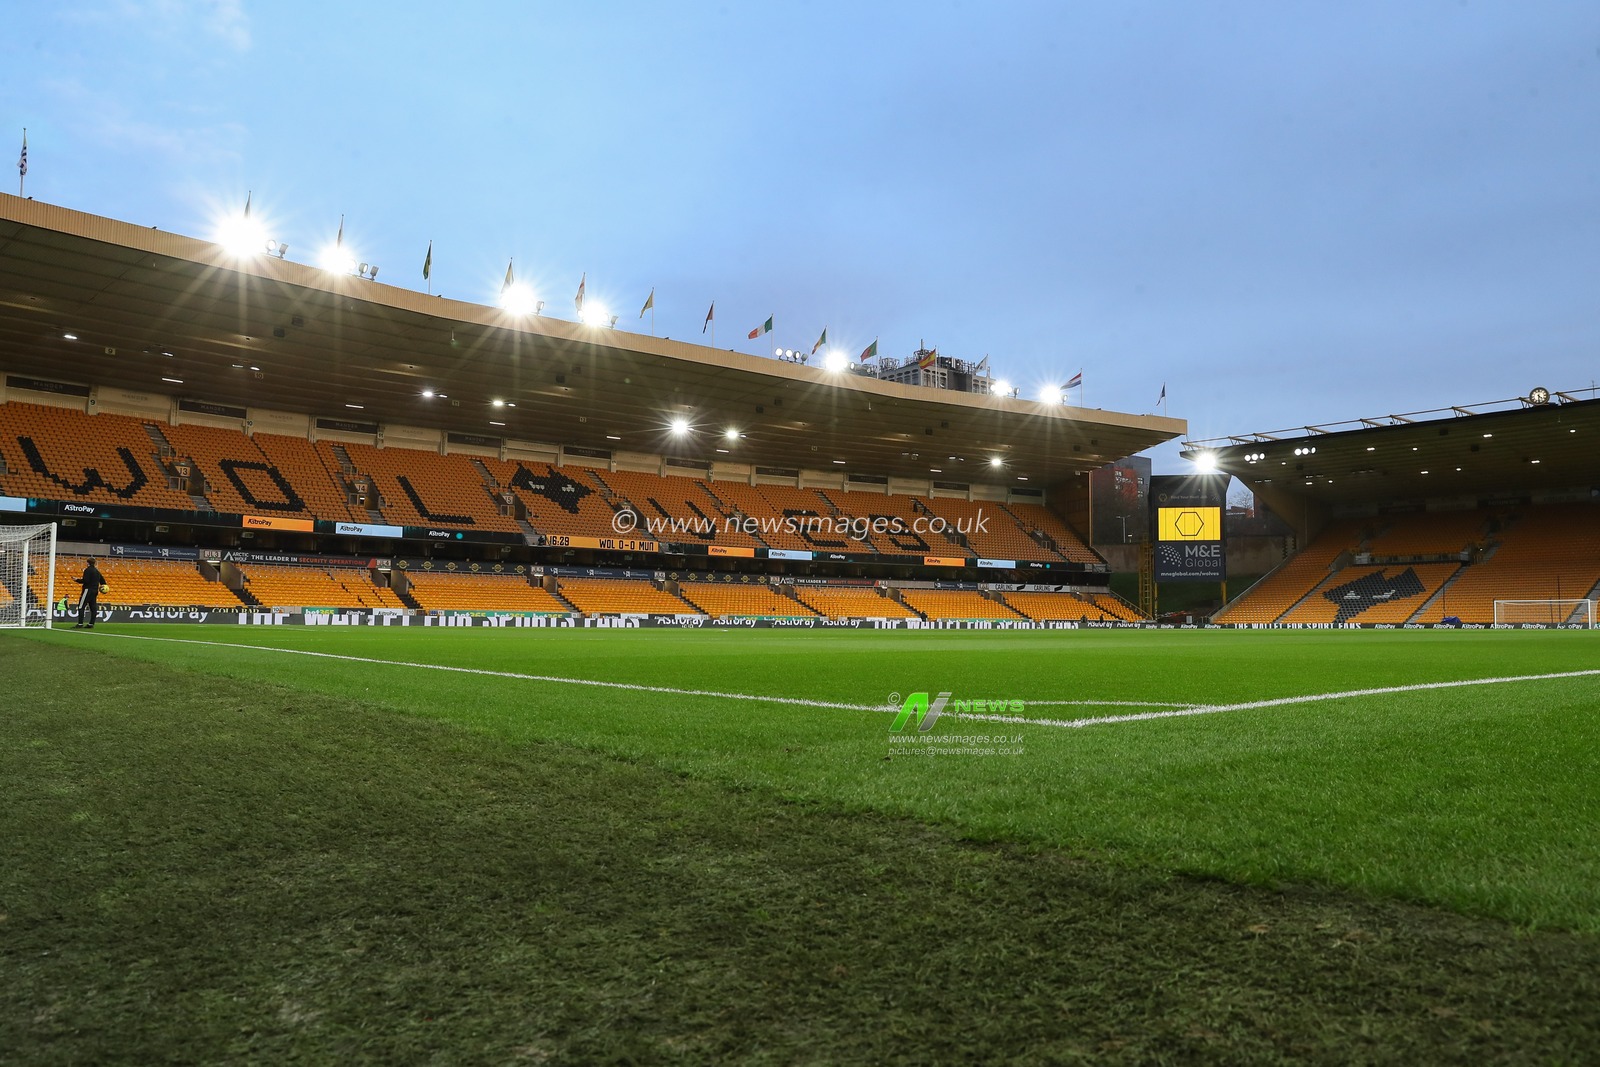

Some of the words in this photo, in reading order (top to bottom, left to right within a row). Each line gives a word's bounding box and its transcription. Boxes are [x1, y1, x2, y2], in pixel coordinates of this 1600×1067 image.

[64, 504, 95, 514] AstroPay
[247, 518, 272, 527] AstroPay
[339, 525, 363, 533] AstroPay
[428, 530, 450, 538] AstroPay
[599, 539, 615, 549] WOL
[1185, 545, 1221, 558] M&E
[1185, 558, 1222, 568] Global
[995, 583, 1013, 591] CARLING
